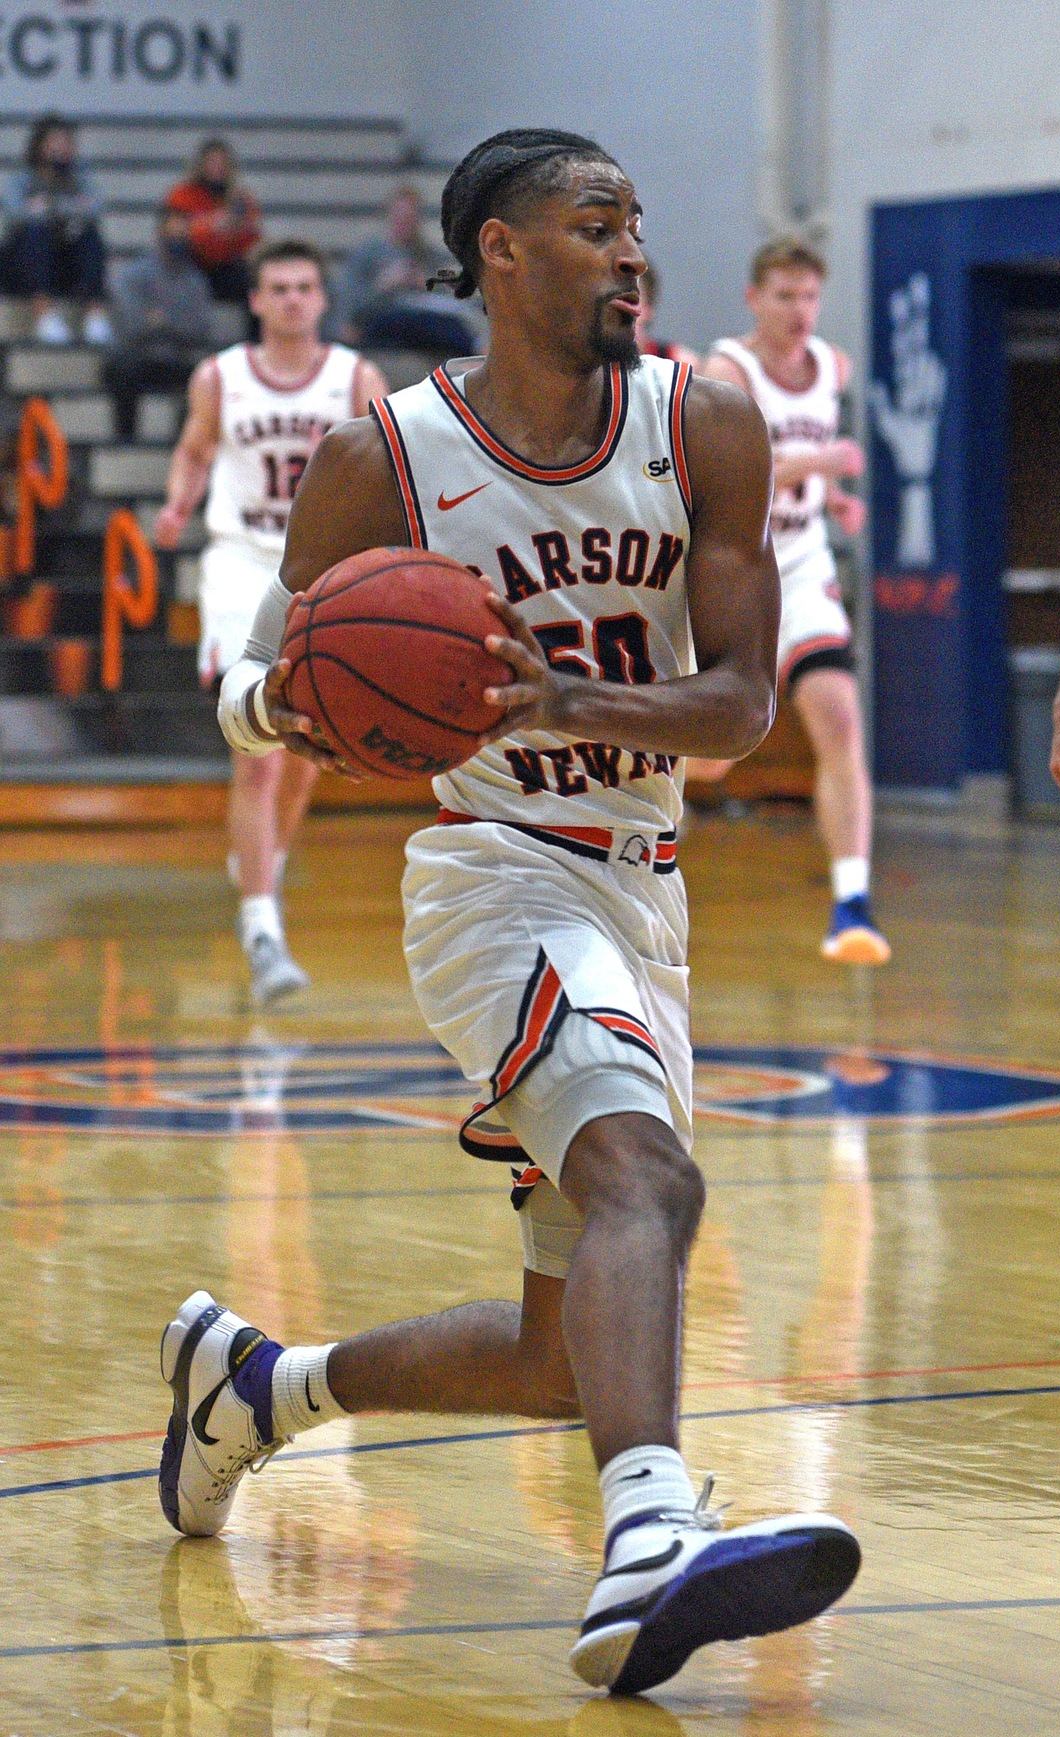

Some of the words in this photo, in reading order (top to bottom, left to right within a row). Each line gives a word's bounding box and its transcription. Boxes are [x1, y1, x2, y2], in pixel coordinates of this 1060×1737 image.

[0, 14, 241, 86] CTION
[465, 528, 684, 604] ARSON
[530, 611, 657, 685] 50
